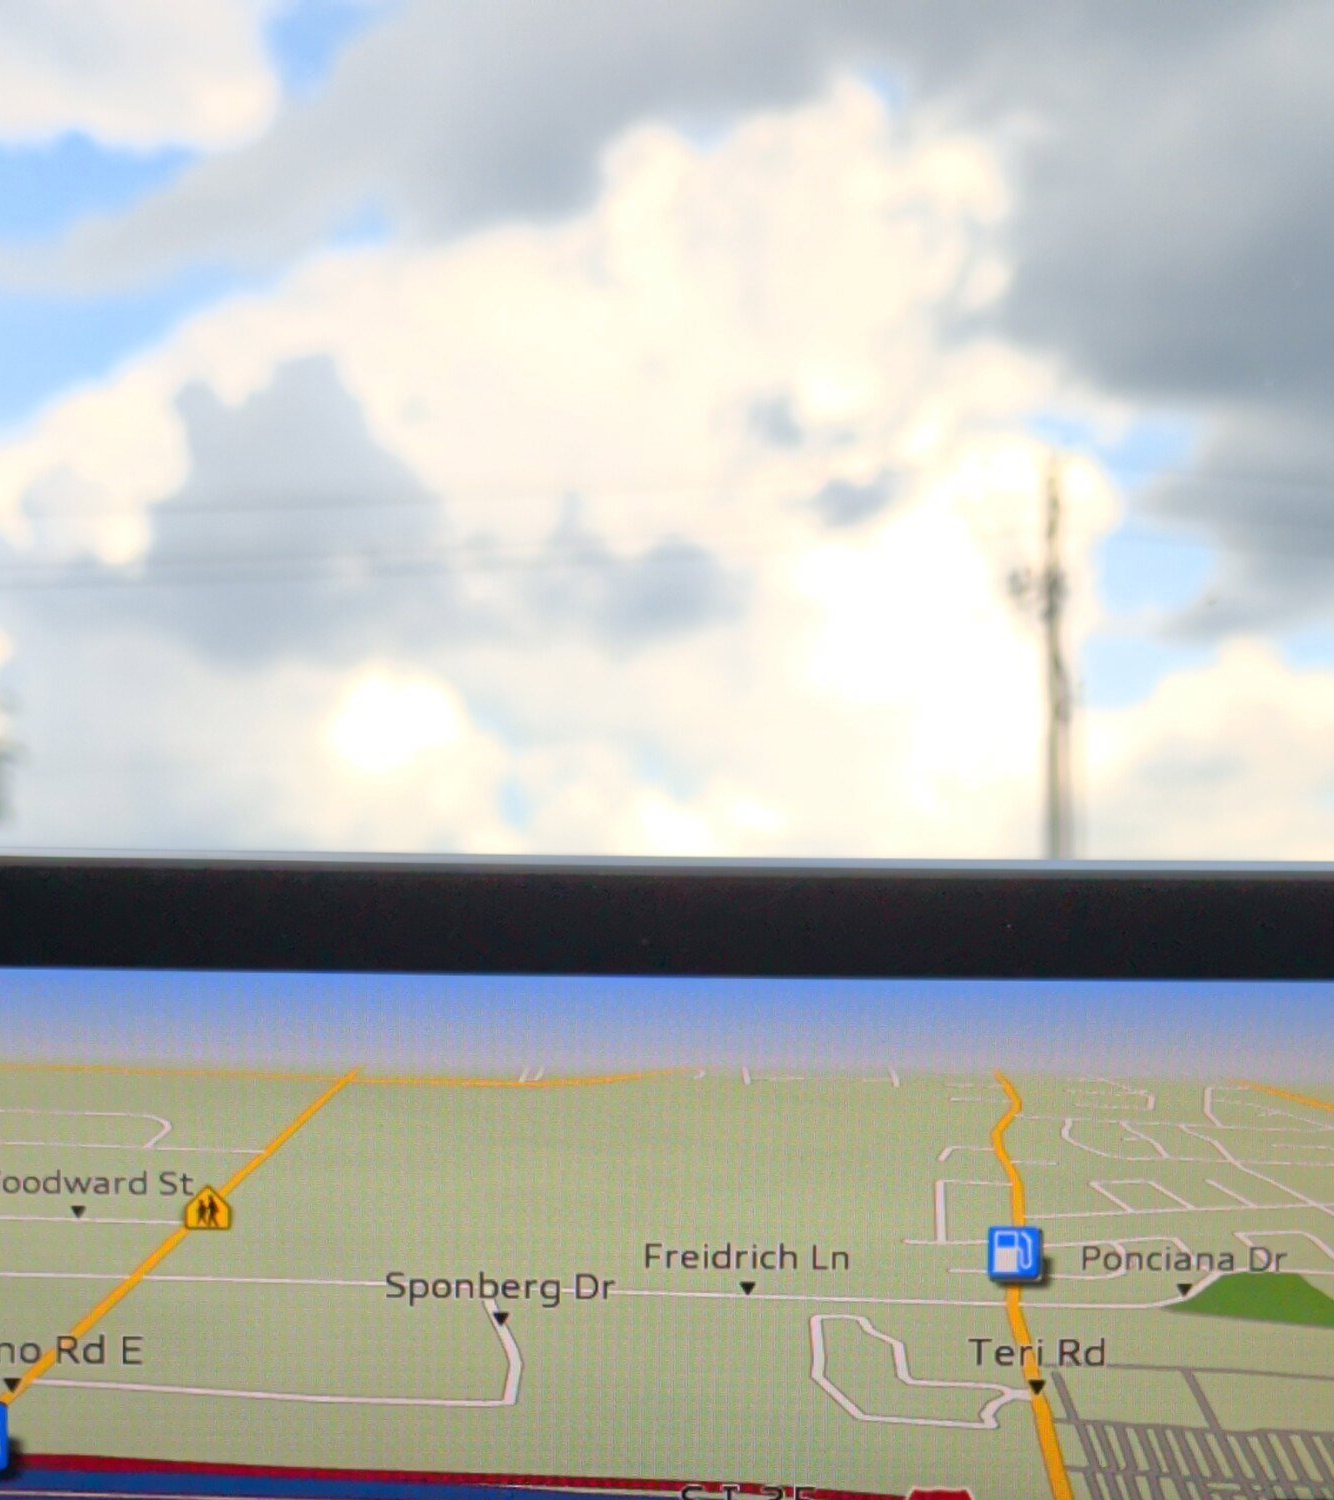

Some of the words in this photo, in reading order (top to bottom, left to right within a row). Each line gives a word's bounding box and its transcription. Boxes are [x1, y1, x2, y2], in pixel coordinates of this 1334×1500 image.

[159, 1170, 194, 1197] St
[644, 1242, 799, 1271] Freidrich
[812, 1244, 851, 1272] Ln
[1080, 1245, 1236, 1273] Ponciana
[1249, 1246, 1288, 1273] Dr
[385, 1271, 562, 1308] Sponberg
[575, 1273, 616, 1300] Dr
[55, 1335, 107, 1366] Rd
[122, 1337, 144, 1365] E
[968, 1337, 1046, 1368] Teri
[1058, 1338, 1107, 1367] Rd
